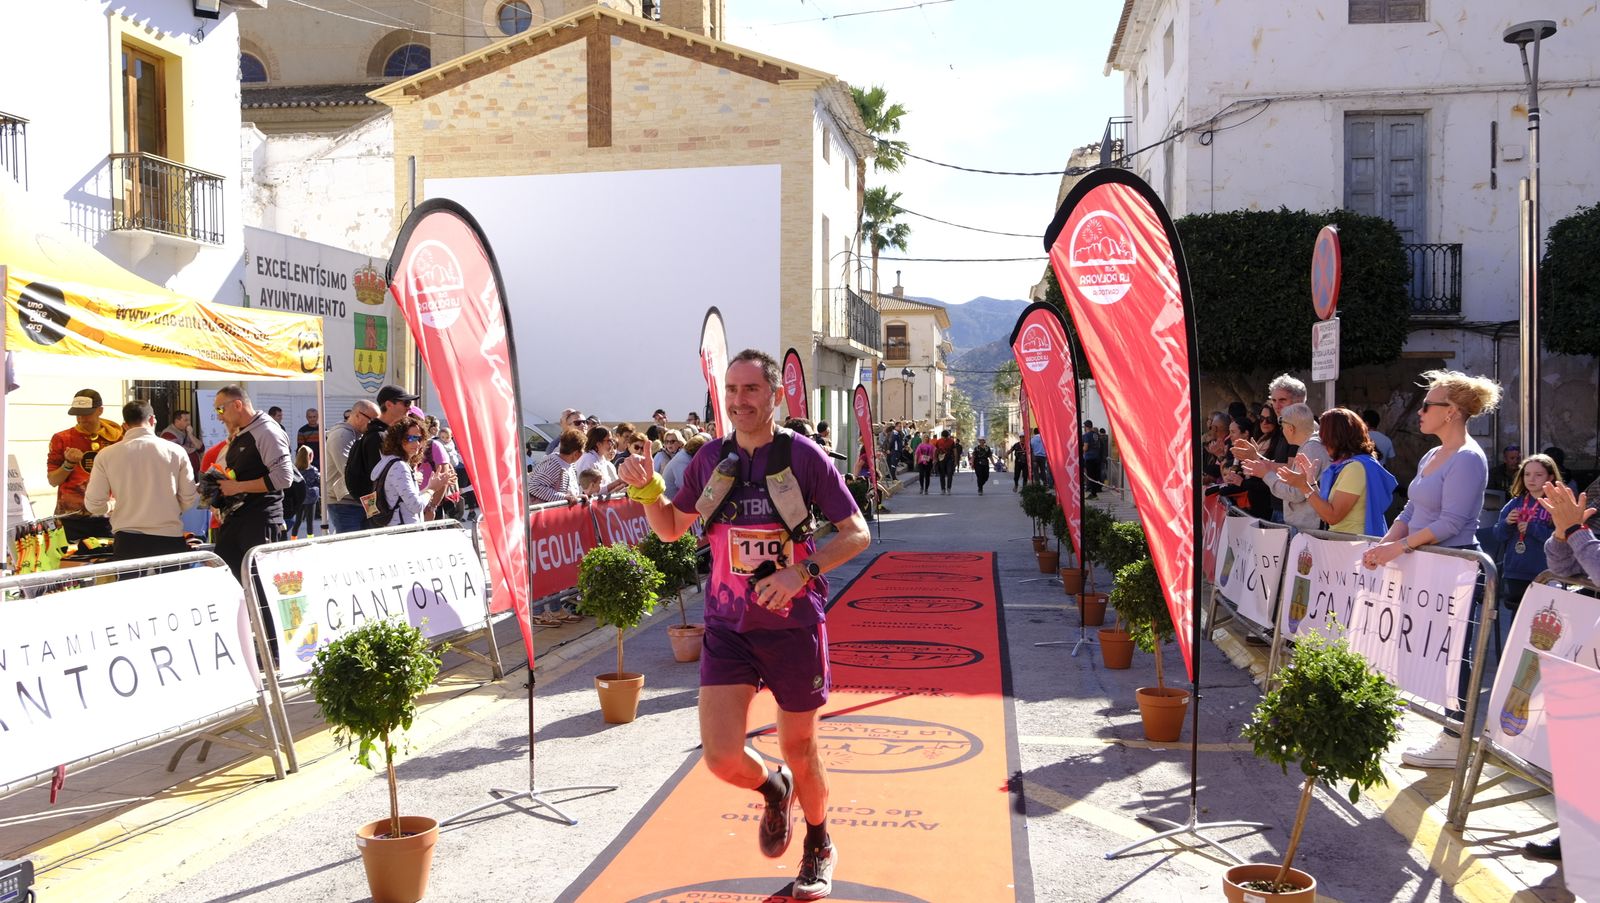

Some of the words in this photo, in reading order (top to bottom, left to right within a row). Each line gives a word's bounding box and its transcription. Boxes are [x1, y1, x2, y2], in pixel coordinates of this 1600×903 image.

[257, 255, 347, 291] EXCELENTÍSIMO
[27, 301, 44, 309] uno
[260, 287, 346, 318] AYUNTAMIENTO
[740, 541, 781, 556] 110
[326, 571, 476, 631] CANTORIA
[1436, 592, 1455, 616] DE
[191, 603, 219, 627] DE
[1309, 590, 1452, 666] CANTORIA
[0, 631, 236, 731] NTORIA
[829, 683, 911, 692] Cantori
[818, 726, 909, 736] POLVO
